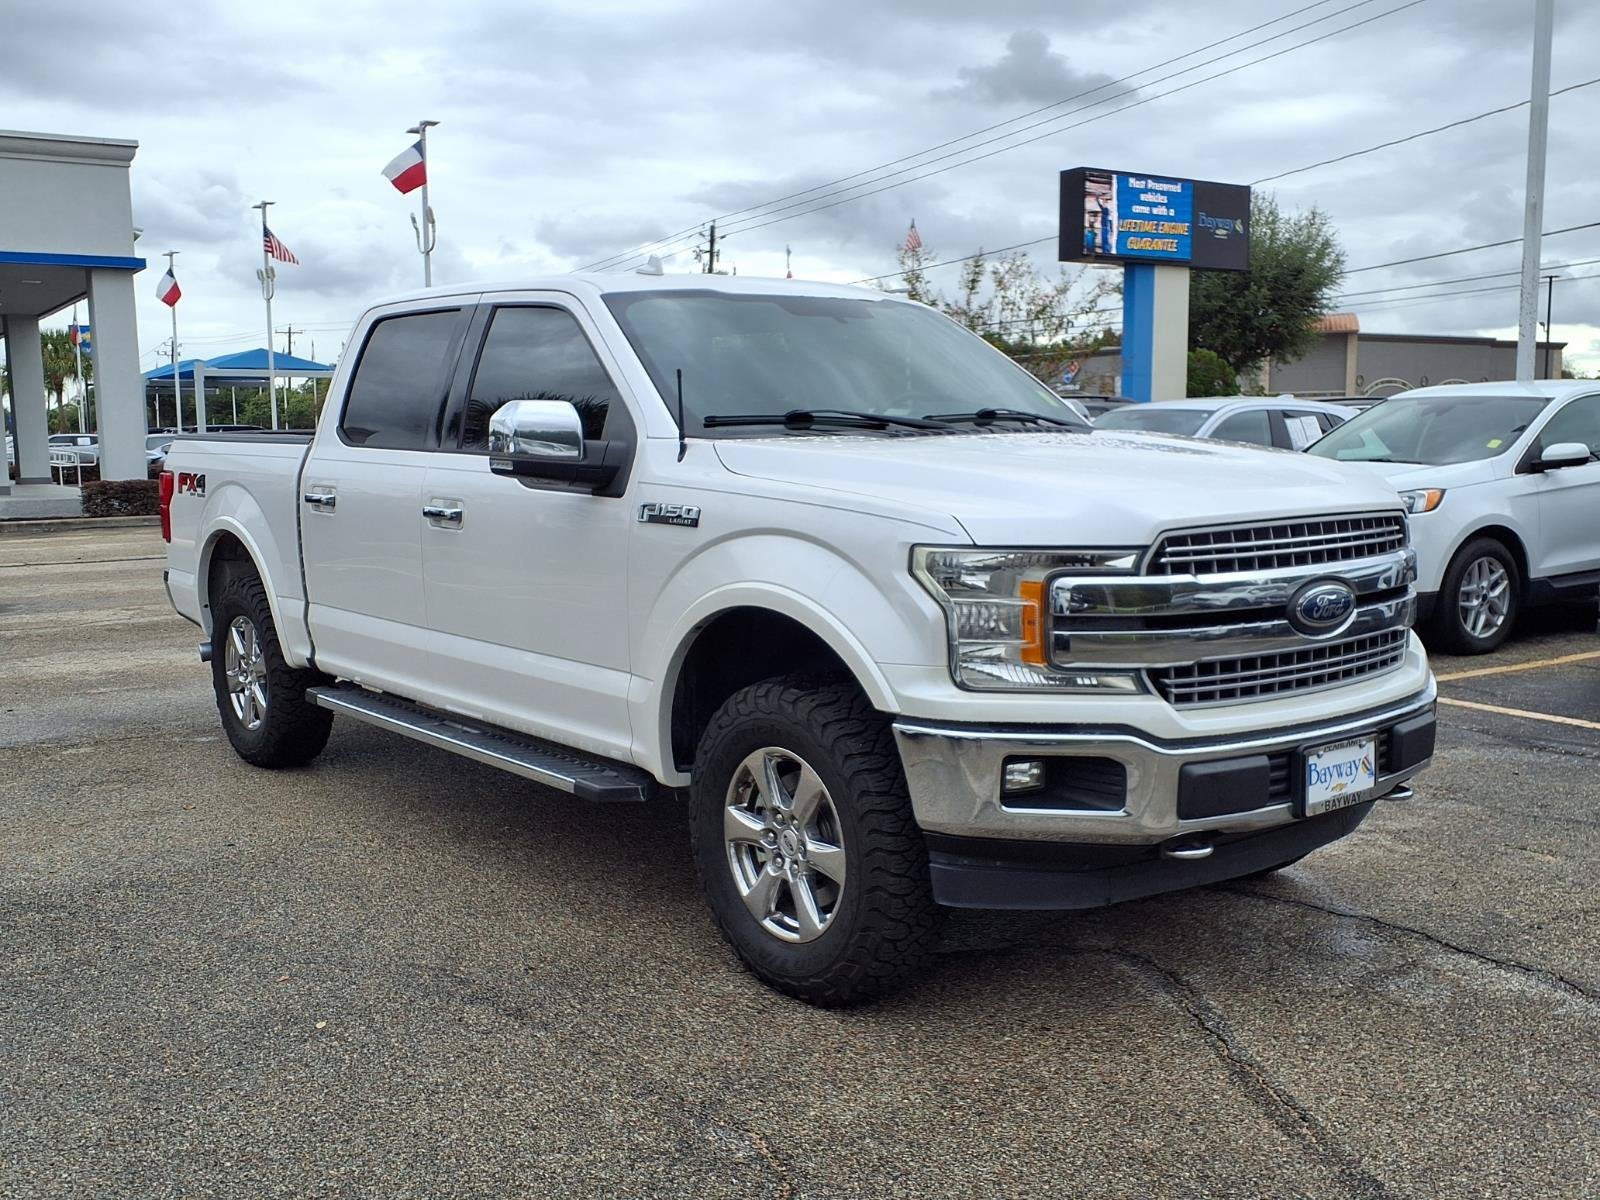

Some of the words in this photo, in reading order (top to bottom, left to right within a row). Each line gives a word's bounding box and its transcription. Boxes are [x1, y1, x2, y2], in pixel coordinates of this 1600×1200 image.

[1152, 205, 1168, 216] with
[1119, 219, 1158, 233] LIFETIME
[1158, 221, 1190, 235] ENGINE
[1127, 236, 1178, 252] GUARANTEE
[178, 472, 206, 494] FX4
[1313, 594, 1345, 619] Ford
[1308, 758, 1361, 791] Bayway
[1324, 790, 1362, 811] BAYWAY
